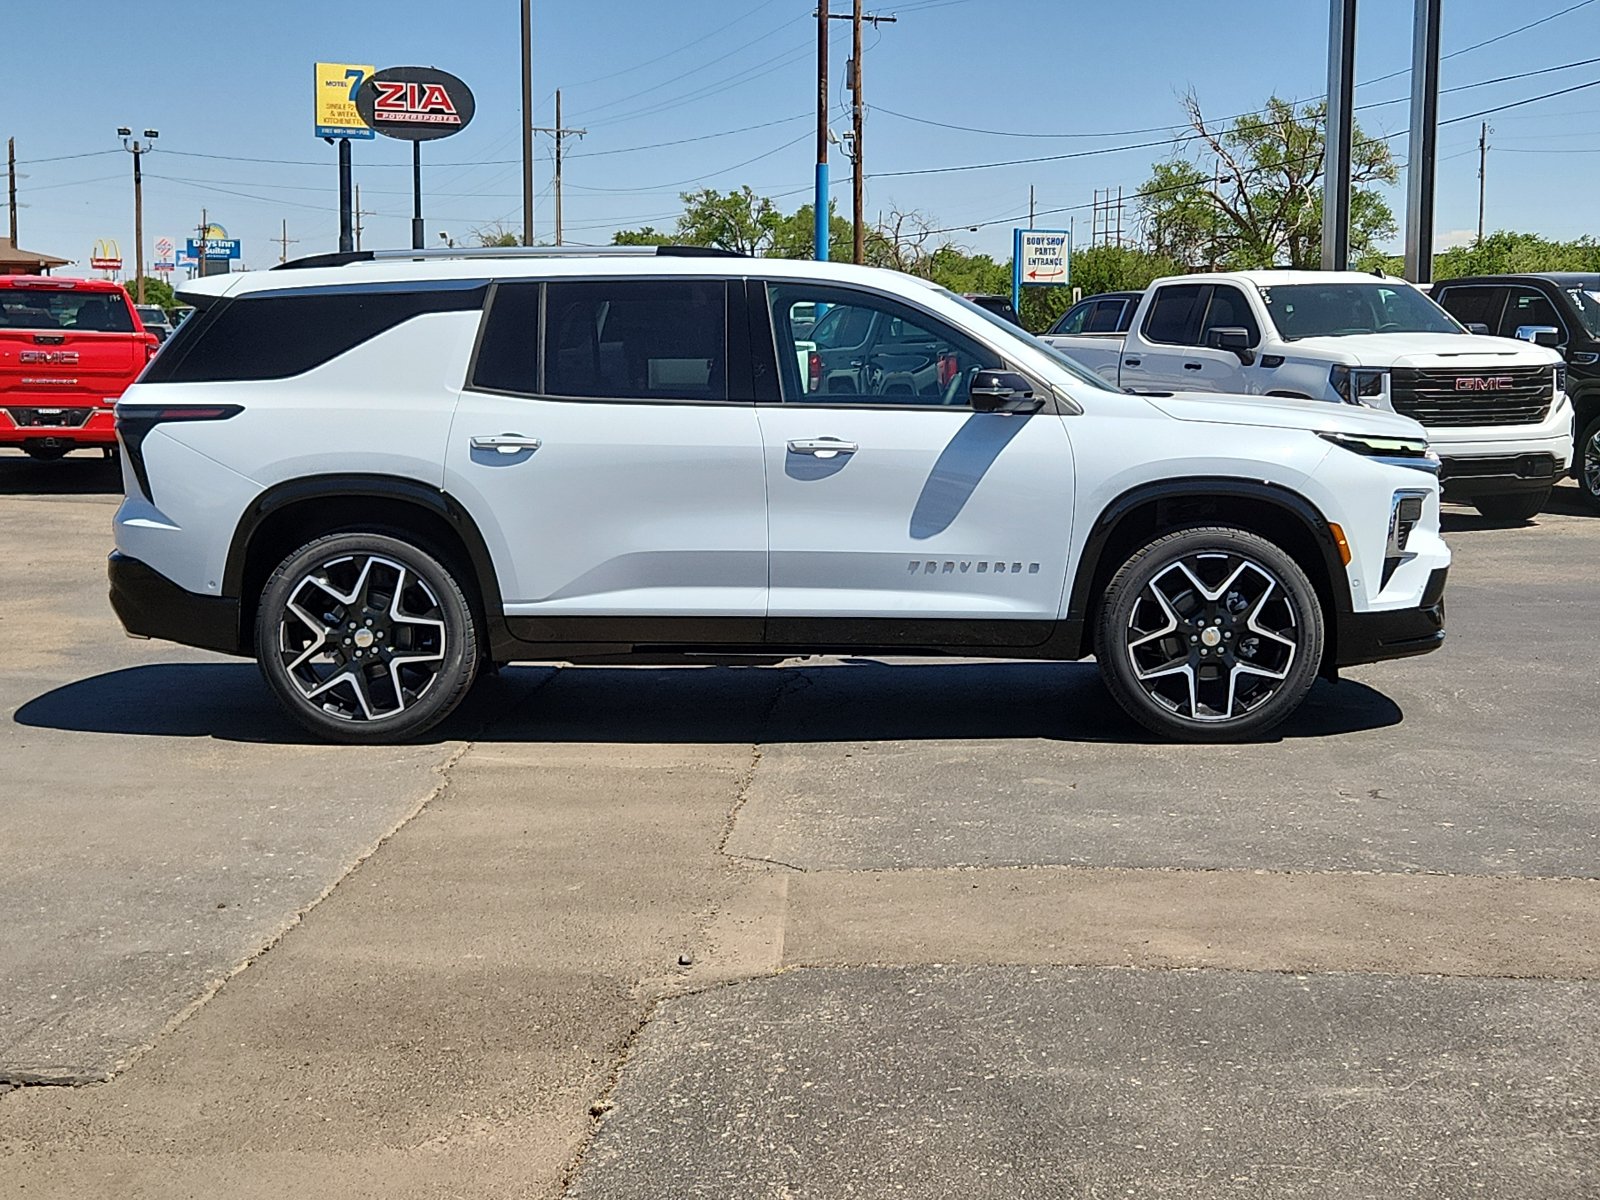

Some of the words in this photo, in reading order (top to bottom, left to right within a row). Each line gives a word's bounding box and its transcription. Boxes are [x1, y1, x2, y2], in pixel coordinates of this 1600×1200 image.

[344, 69, 365, 101] 7
[373, 81, 457, 113] ZIA
[383, 113, 454, 122] POWERSPORTS
[218, 240, 235, 248] Inn
[1027, 237, 1045, 246] BODY
[1046, 237, 1065, 246] SHOP
[204, 246, 230, 255] Suites
[1034, 248, 1057, 256] PARTS
[1028, 258, 1063, 266] ENTRANCE
[20, 351, 79, 364] GMC
[1455, 377, 1513, 391] GMC
[907, 560, 1041, 575] TRAVERSE
